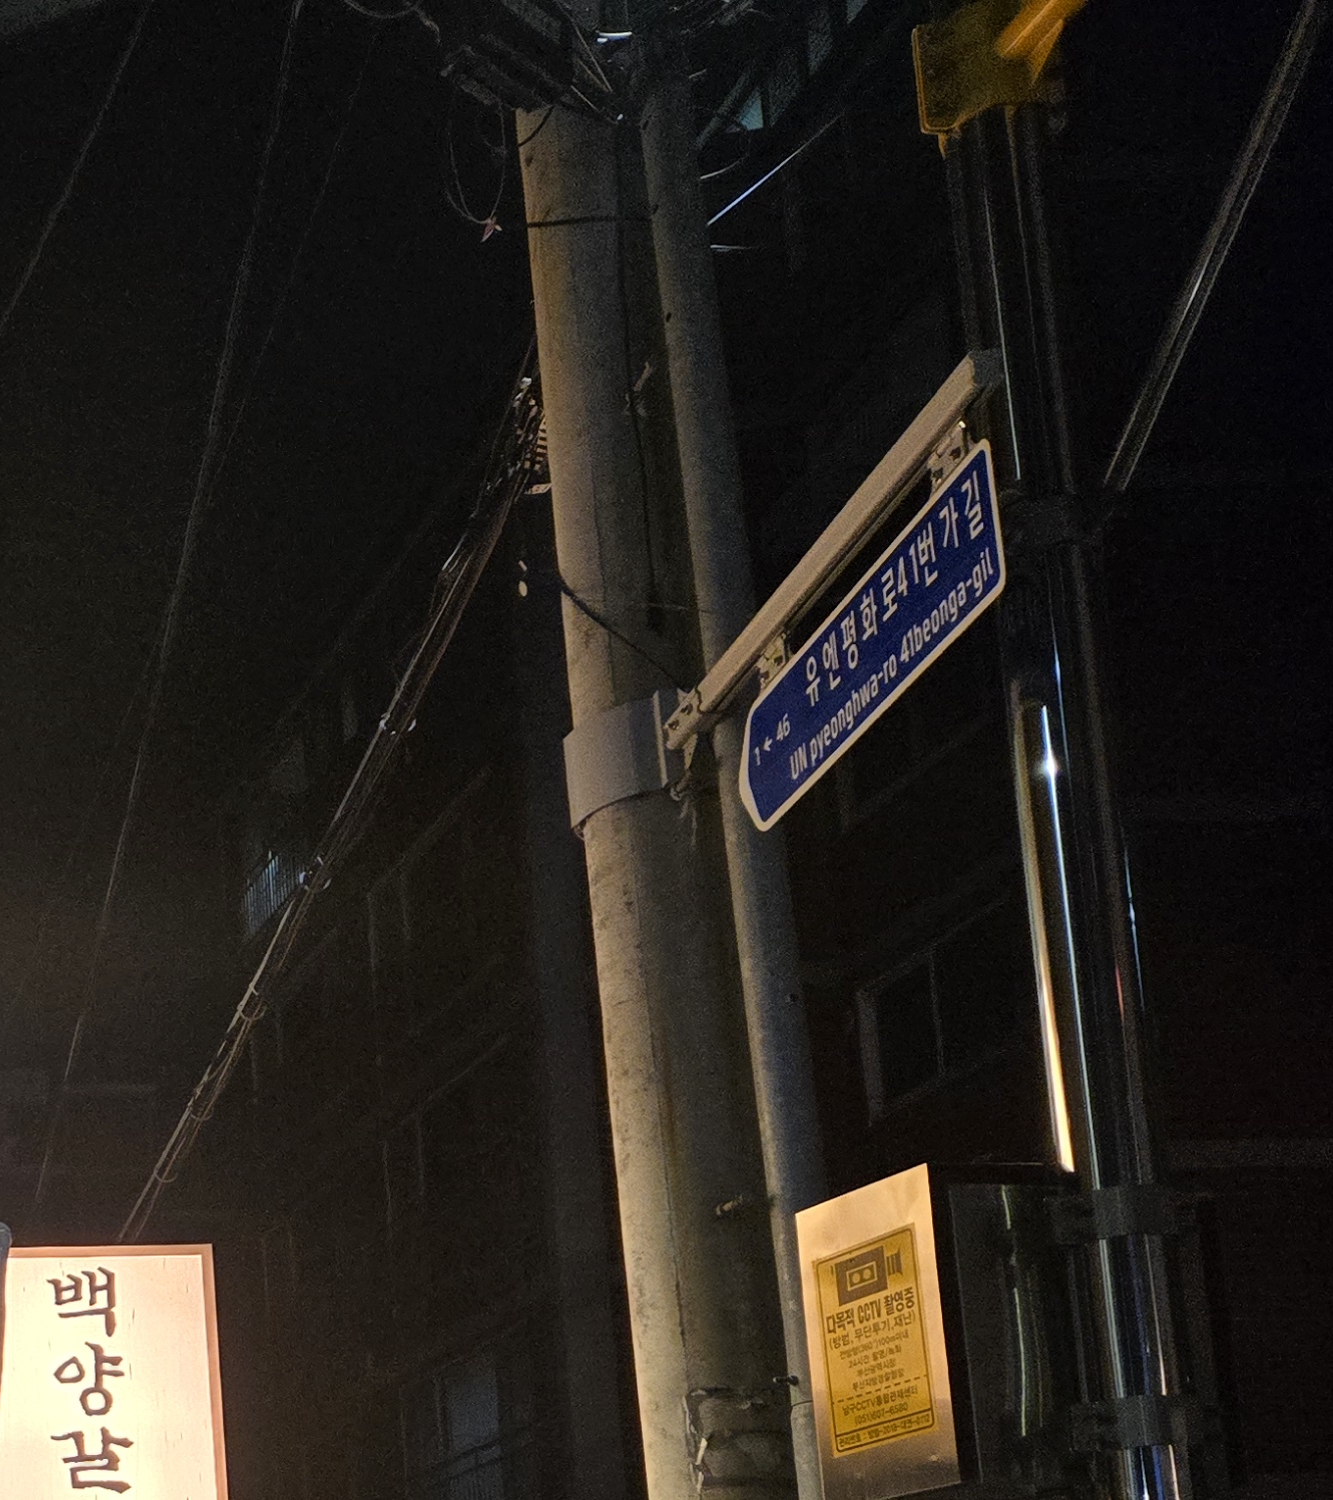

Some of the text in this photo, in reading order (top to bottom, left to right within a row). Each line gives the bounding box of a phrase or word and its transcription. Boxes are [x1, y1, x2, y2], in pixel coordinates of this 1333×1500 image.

[789, 547, 994, 781] UN pyeonghwa-ro 41beonga-gil
[775, 713, 791, 742] 46
[825, 1286, 915, 1335] 다목적 CCTV 촬영중
